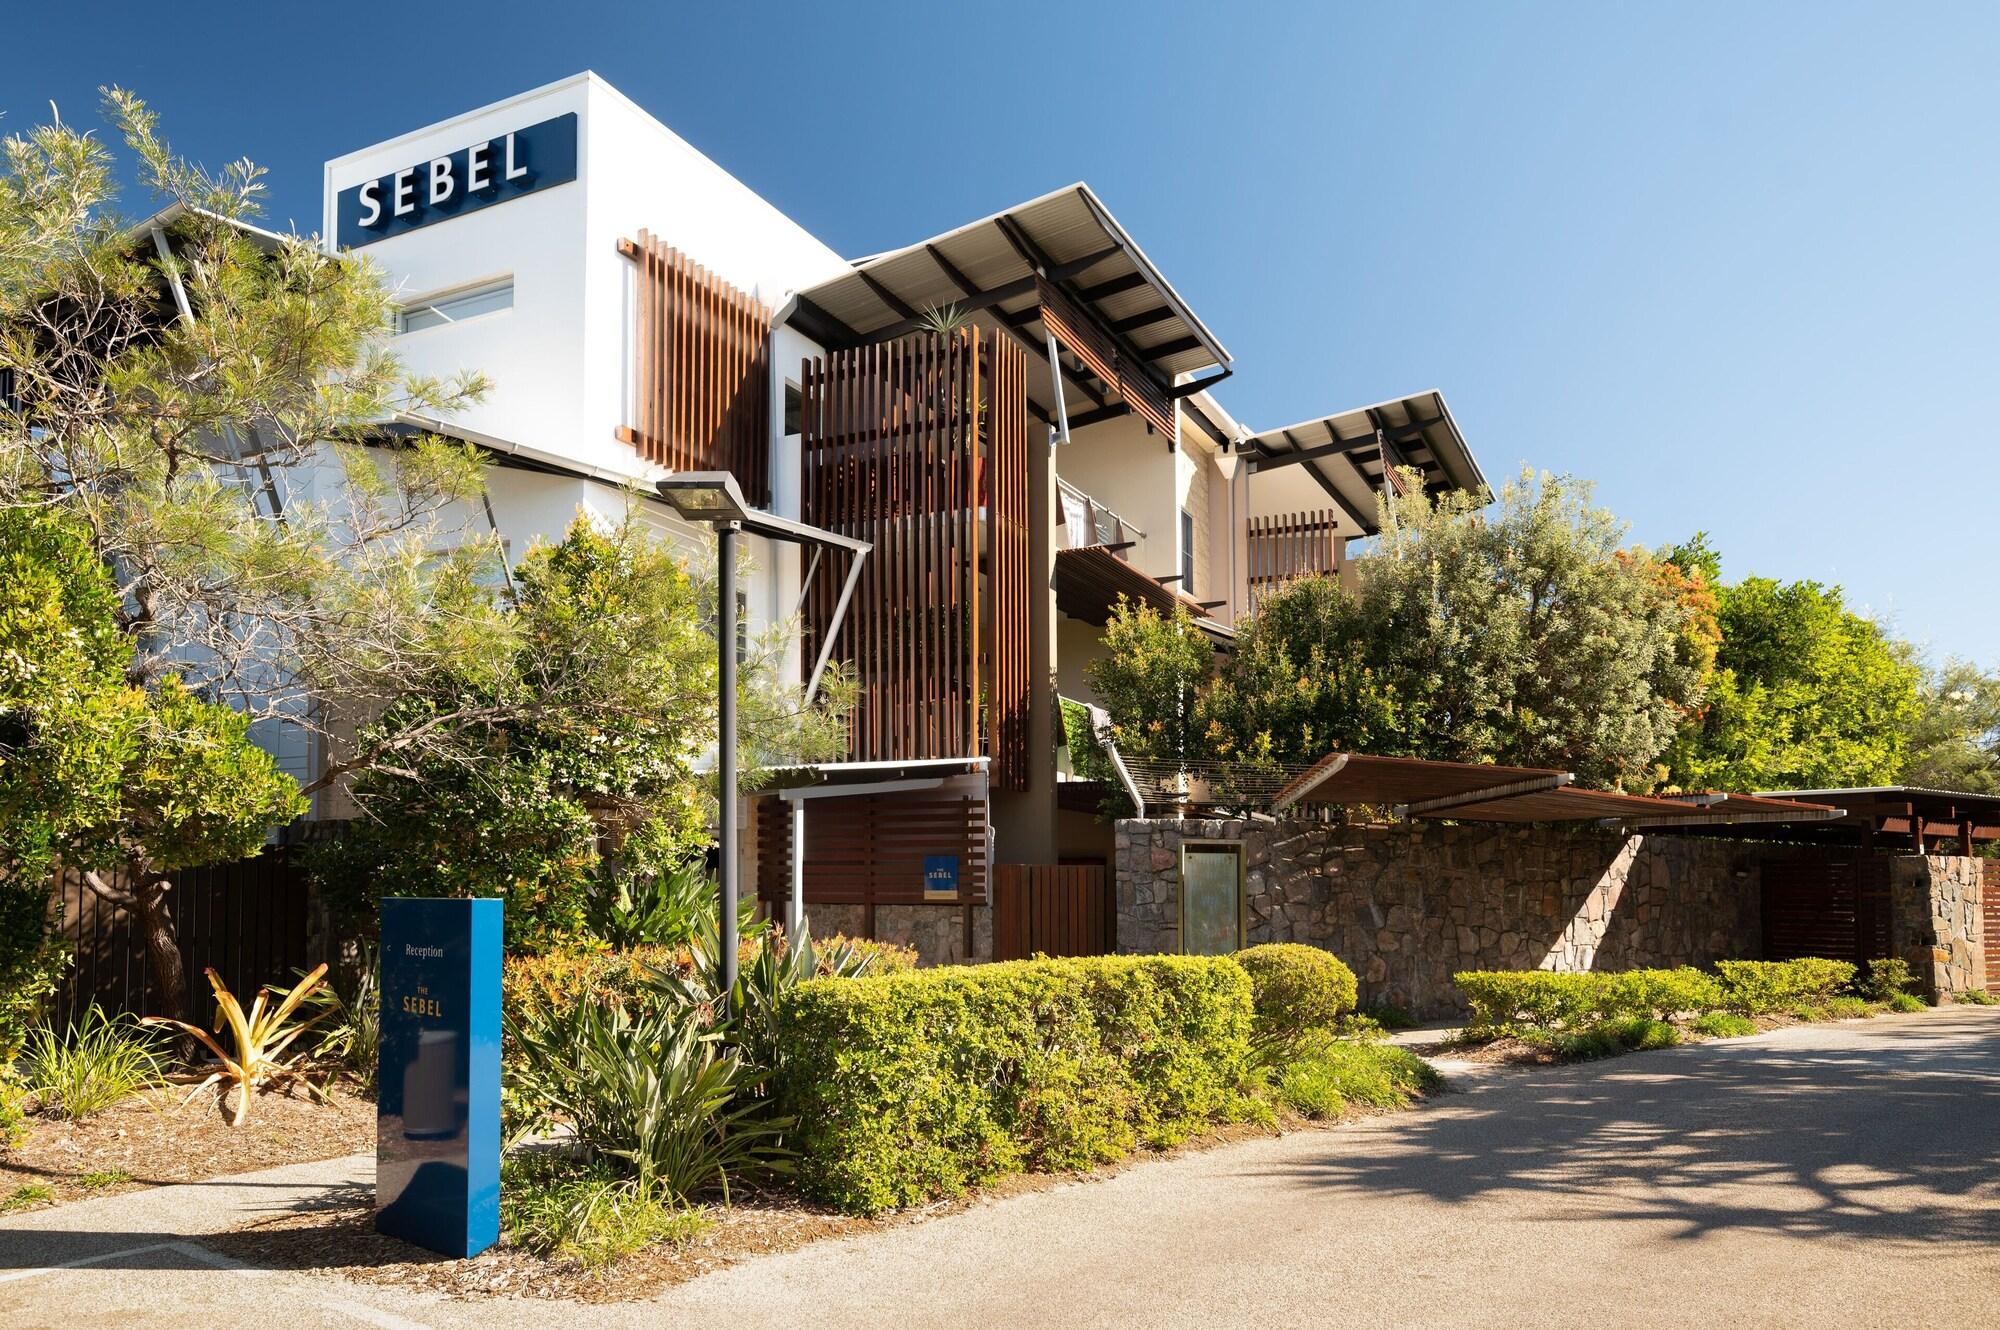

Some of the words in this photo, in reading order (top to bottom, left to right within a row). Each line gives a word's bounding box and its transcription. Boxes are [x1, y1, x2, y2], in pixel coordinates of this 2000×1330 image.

[358, 132, 528, 227] SEBEL
[405, 943, 443, 959] Reception
[417, 986, 429, 995] THE
[403, 996, 442, 1017] SEBEL
